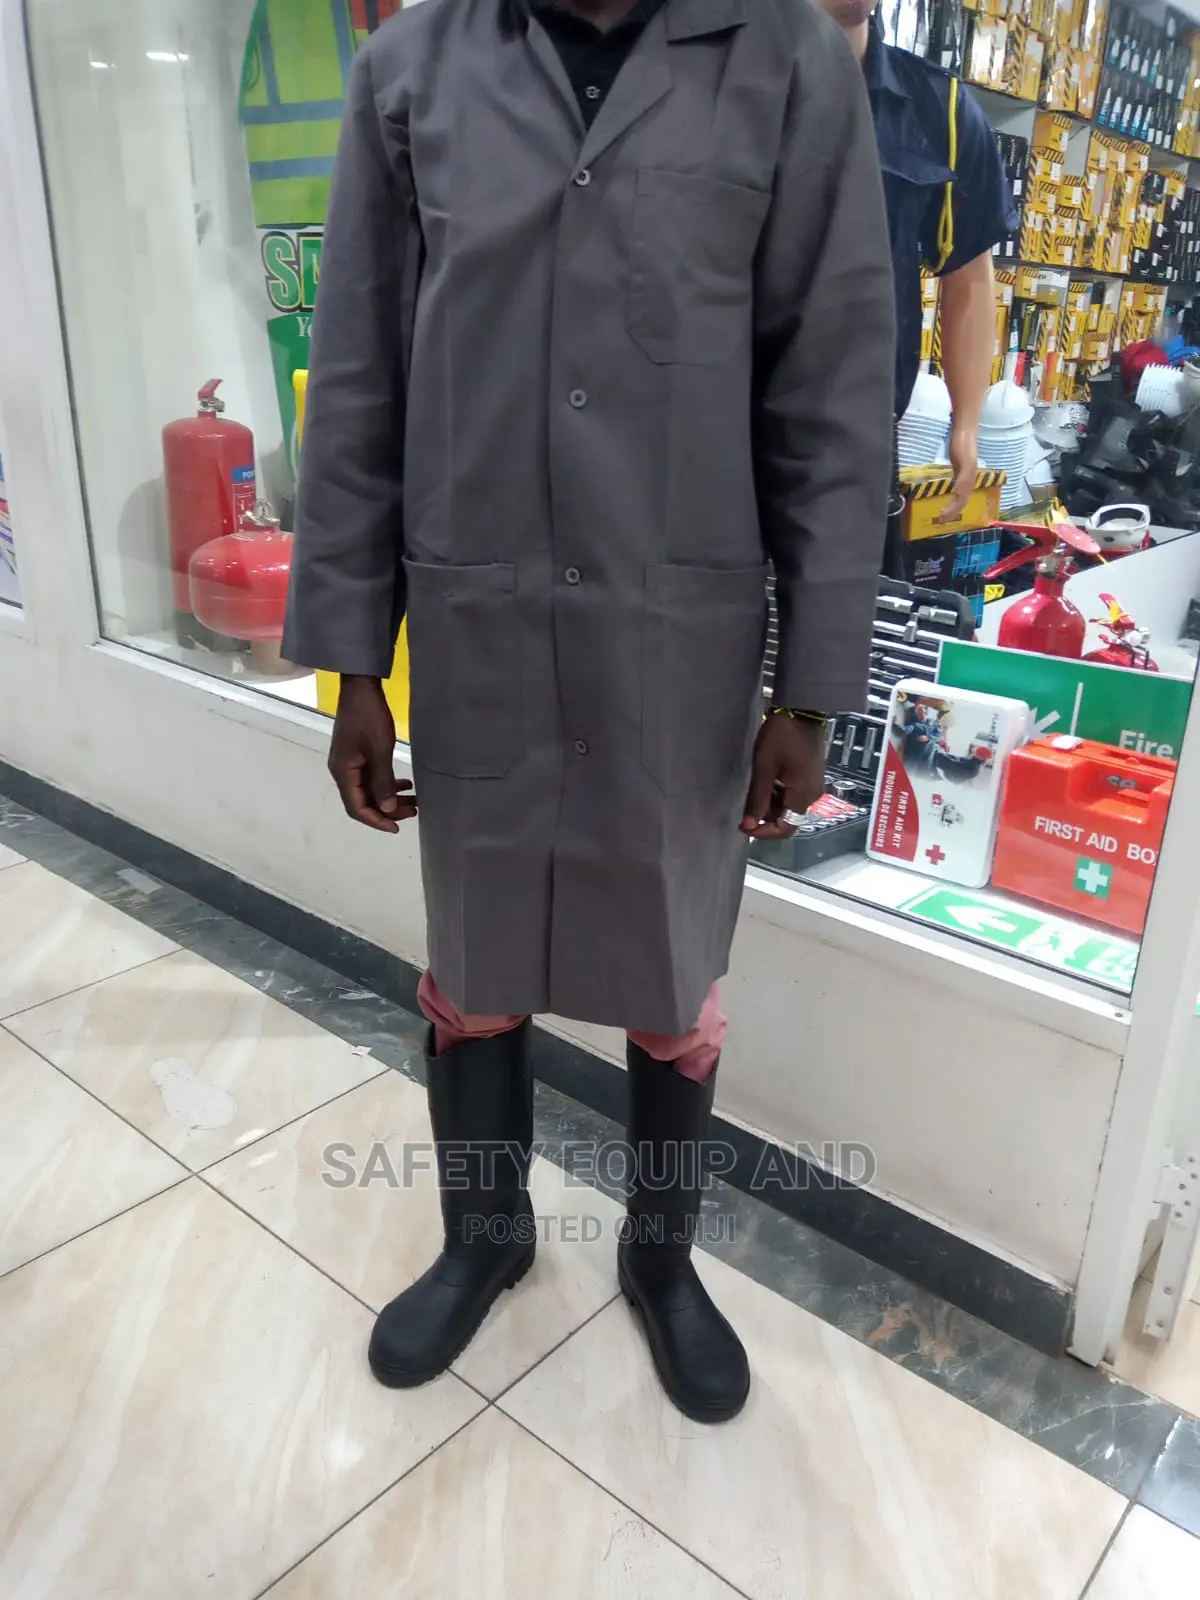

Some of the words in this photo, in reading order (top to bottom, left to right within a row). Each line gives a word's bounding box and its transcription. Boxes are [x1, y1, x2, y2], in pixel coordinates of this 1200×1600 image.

[1120, 730, 1174, 760] Fire
[883, 771, 896, 803] TROUSSE
[881, 804, 890, 814] DE
[896, 791, 909, 815] FIRST
[875, 814, 889, 848] SECOURS
[893, 817, 904, 831] AID
[891, 833, 901, 848] KIT
[1034, 816, 1085, 843] FIRST
[1086, 832, 1118, 853] AID
[1126, 843, 1159, 866] BO
